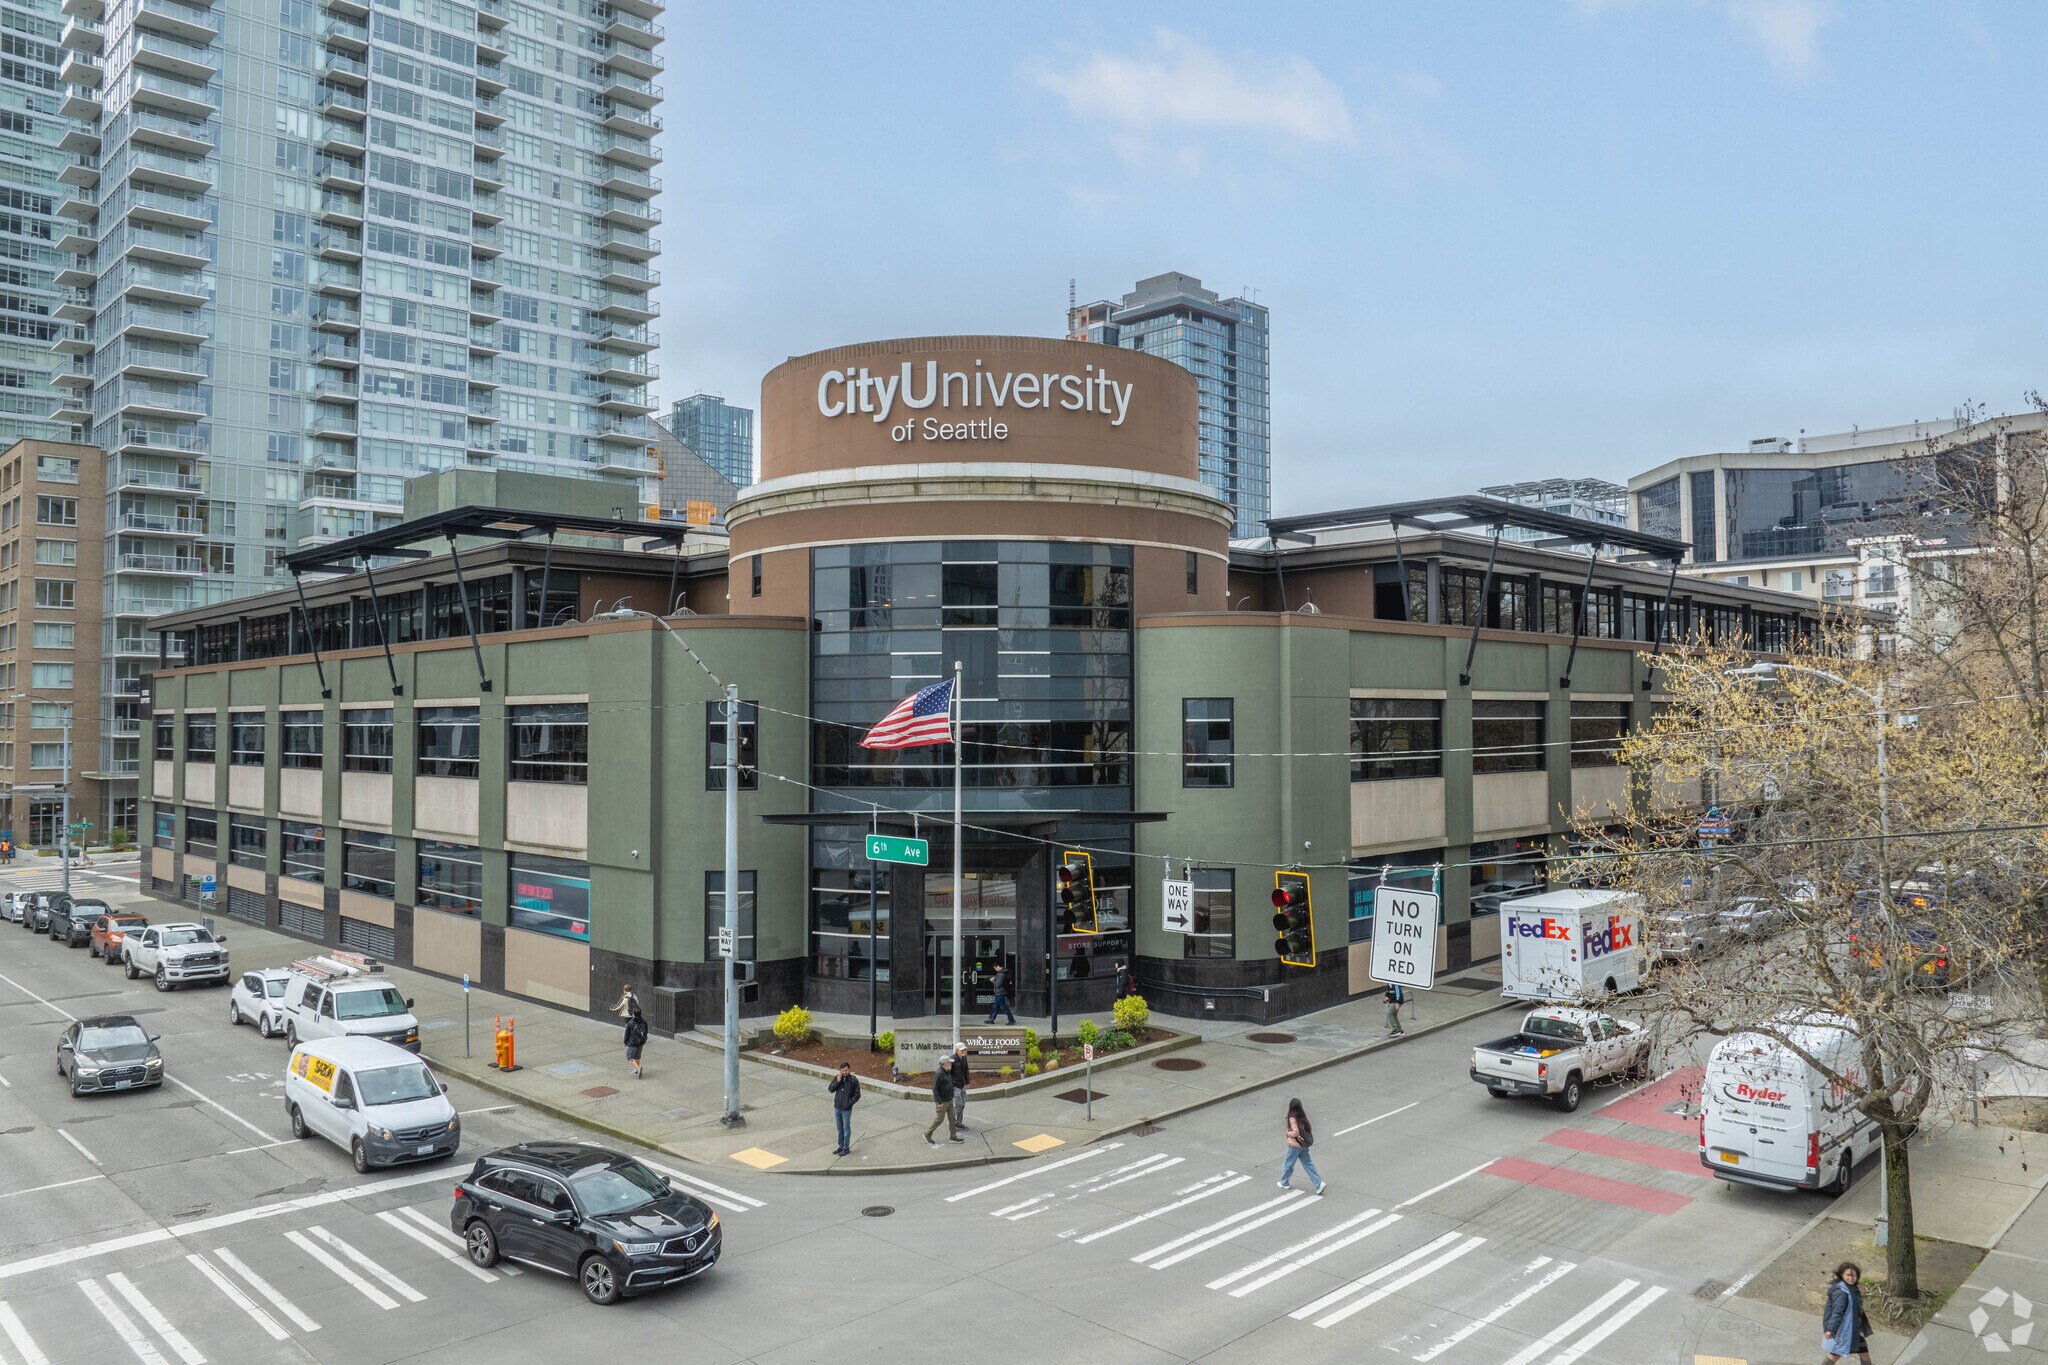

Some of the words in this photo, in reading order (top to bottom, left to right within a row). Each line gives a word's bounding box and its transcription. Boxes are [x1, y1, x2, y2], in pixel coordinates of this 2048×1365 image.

[818, 359, 1133, 426] CityUniversity
[892, 418, 915, 442] of
[923, 417, 1008, 440] Seattle
[873, 841, 888, 854] 6th
[904, 845, 921, 857] Ave
[1168, 885, 1188, 897] ONE
[934, 894, 1007, 905] Cityniversity
[1168, 898, 1188, 911] WAY
[1391, 899, 1420, 919] NO
[721, 930, 732, 938] ONE
[1386, 921, 1422, 939] TURN
[1508, 916, 1571, 941] FedEx
[1067, 942, 1091, 950] STORE
[1093, 939, 1124, 948] SUPPORT
[1582, 915, 1633, 960] FedEx
[1393, 941, 1412, 956] ON
[1388, 959, 1415, 975] RED
[1736, 1083, 1787, 1101] Ryder
[1754, 1099, 1770, 1107] Ever
